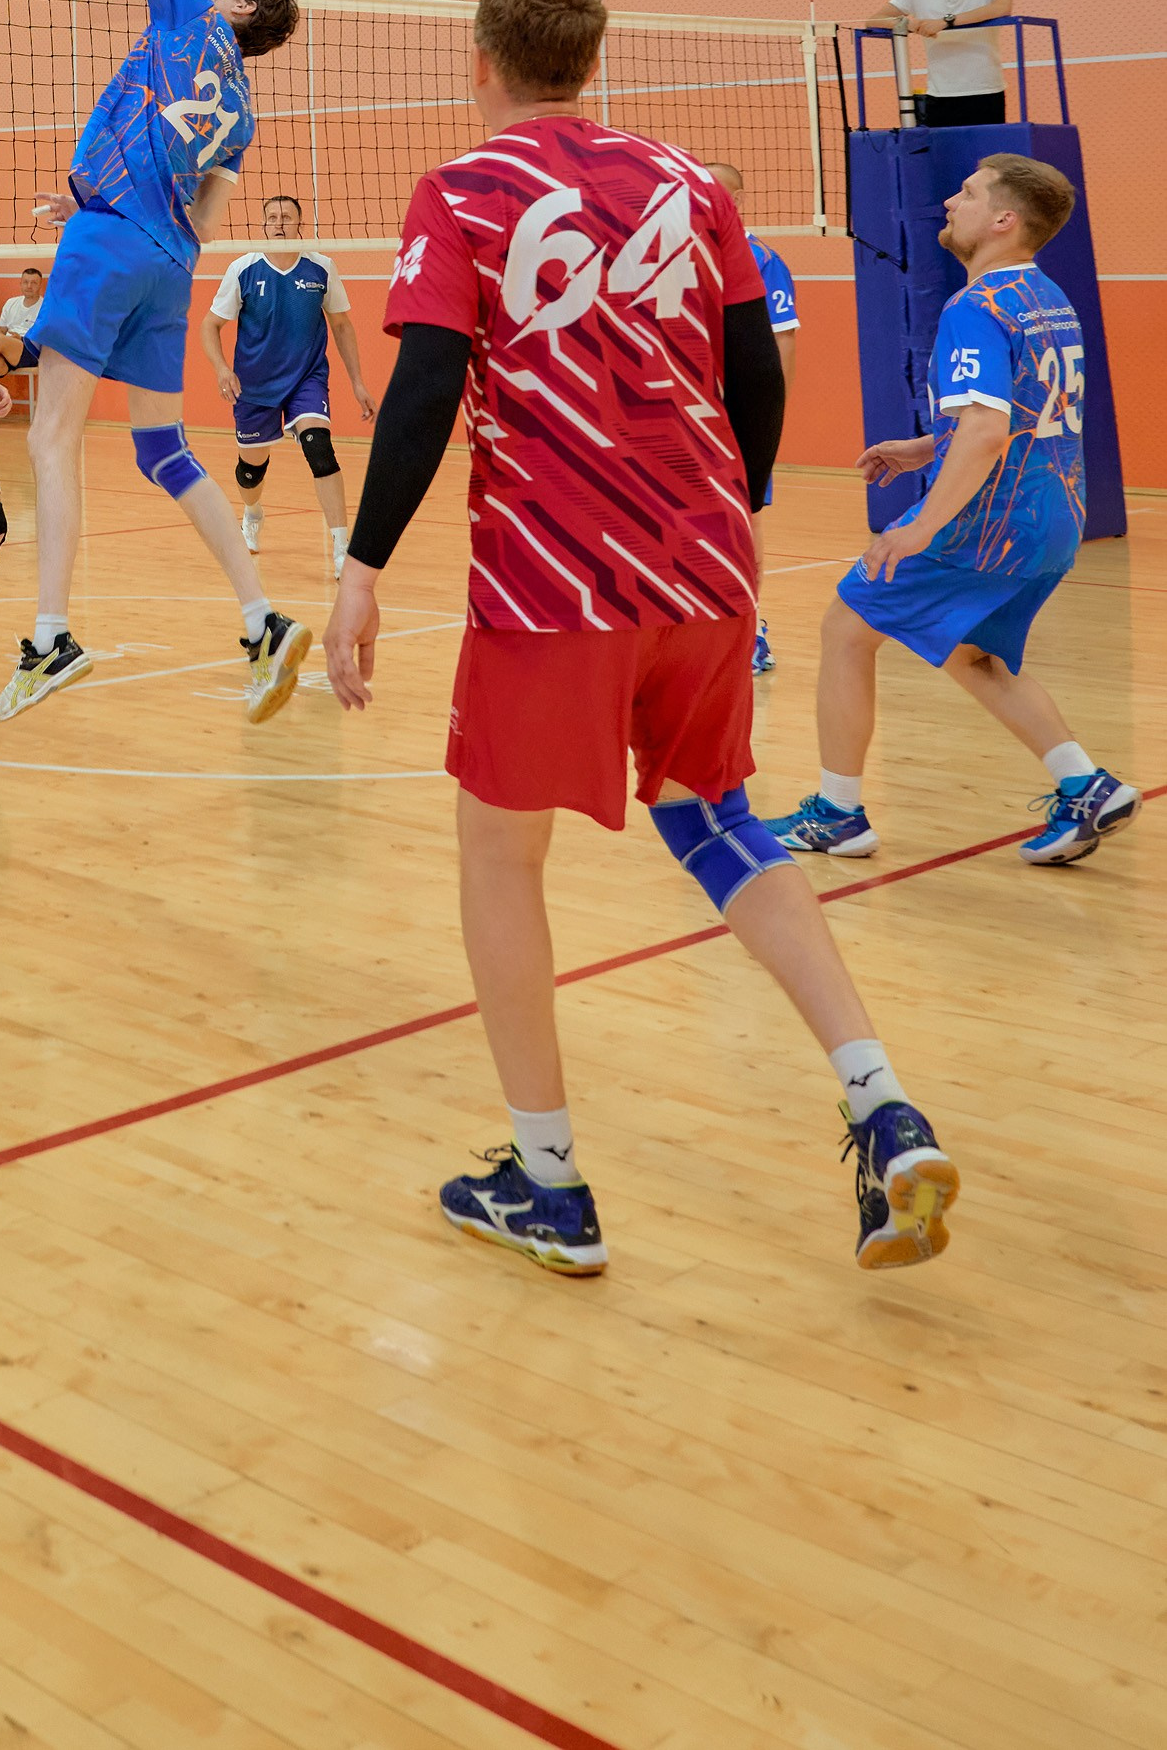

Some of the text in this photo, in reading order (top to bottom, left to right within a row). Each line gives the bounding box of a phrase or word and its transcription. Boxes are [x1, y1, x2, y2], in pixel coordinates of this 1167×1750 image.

[160, 69, 241, 170] 21
[256, 280, 266, 297] 7
[500, 178, 701, 350] 64
[950, 348, 981, 383] 25
[1036, 344, 1085, 439] 25
